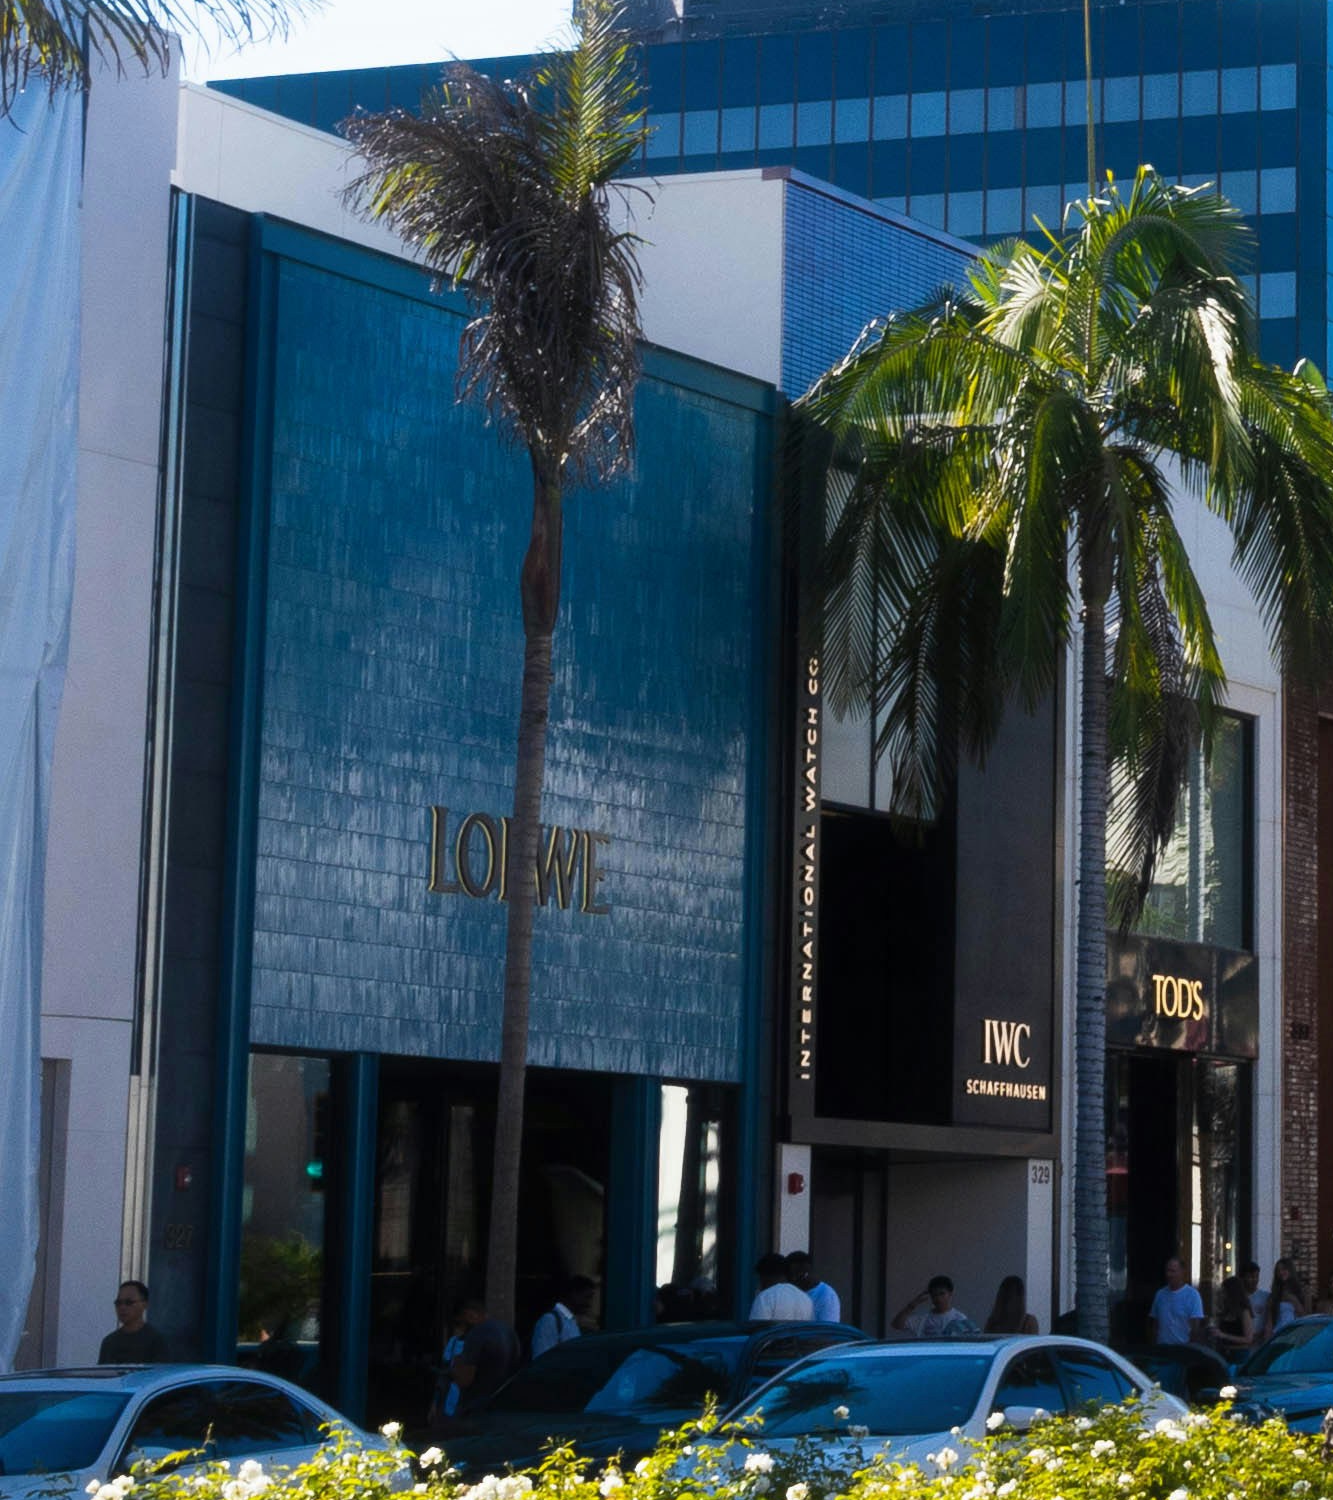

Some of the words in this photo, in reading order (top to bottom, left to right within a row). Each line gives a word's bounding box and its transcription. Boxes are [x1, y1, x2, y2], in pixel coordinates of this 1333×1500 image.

[805, 708, 818, 812] WATCH
[800, 824, 816, 1080] INTERNATIONAL
[1152, 974, 1204, 1021] TOD'S
[984, 1019, 1031, 1069] IWC
[966, 1079, 1046, 1101] SCHAFFHAUSEN
[1031, 1165, 1050, 1185] 329
